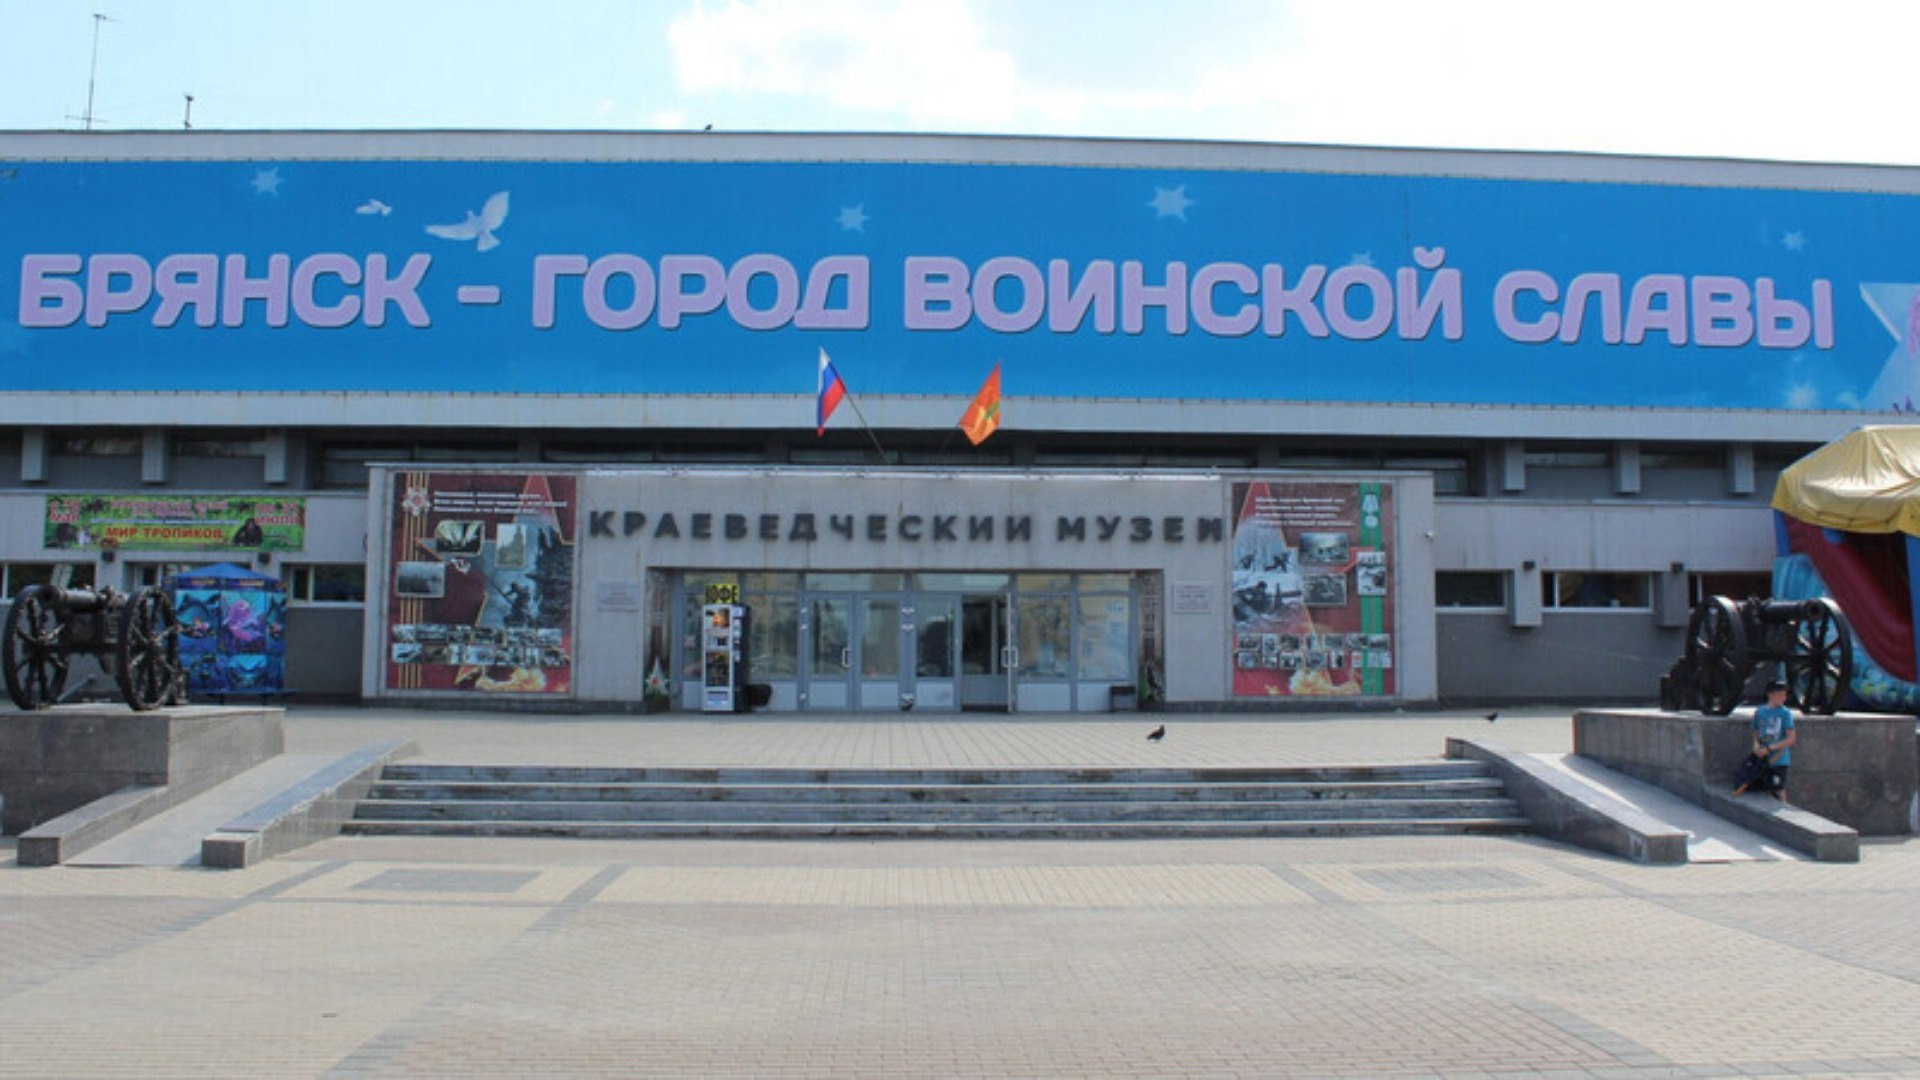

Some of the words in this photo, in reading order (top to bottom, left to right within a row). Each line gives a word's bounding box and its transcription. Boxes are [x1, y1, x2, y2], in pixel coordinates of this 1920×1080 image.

[19, 253, 432, 329] БРЯНСК
[456, 285, 501, 305] -
[531, 253, 871, 332] ГОРОД
[903, 246, 1464, 341] ВОИНСКОЙ
[1492, 269, 1835, 350] СЛАВЫ
[106, 527, 138, 538] МИР
[143, 527, 223, 539] ТРОПИКОВ
